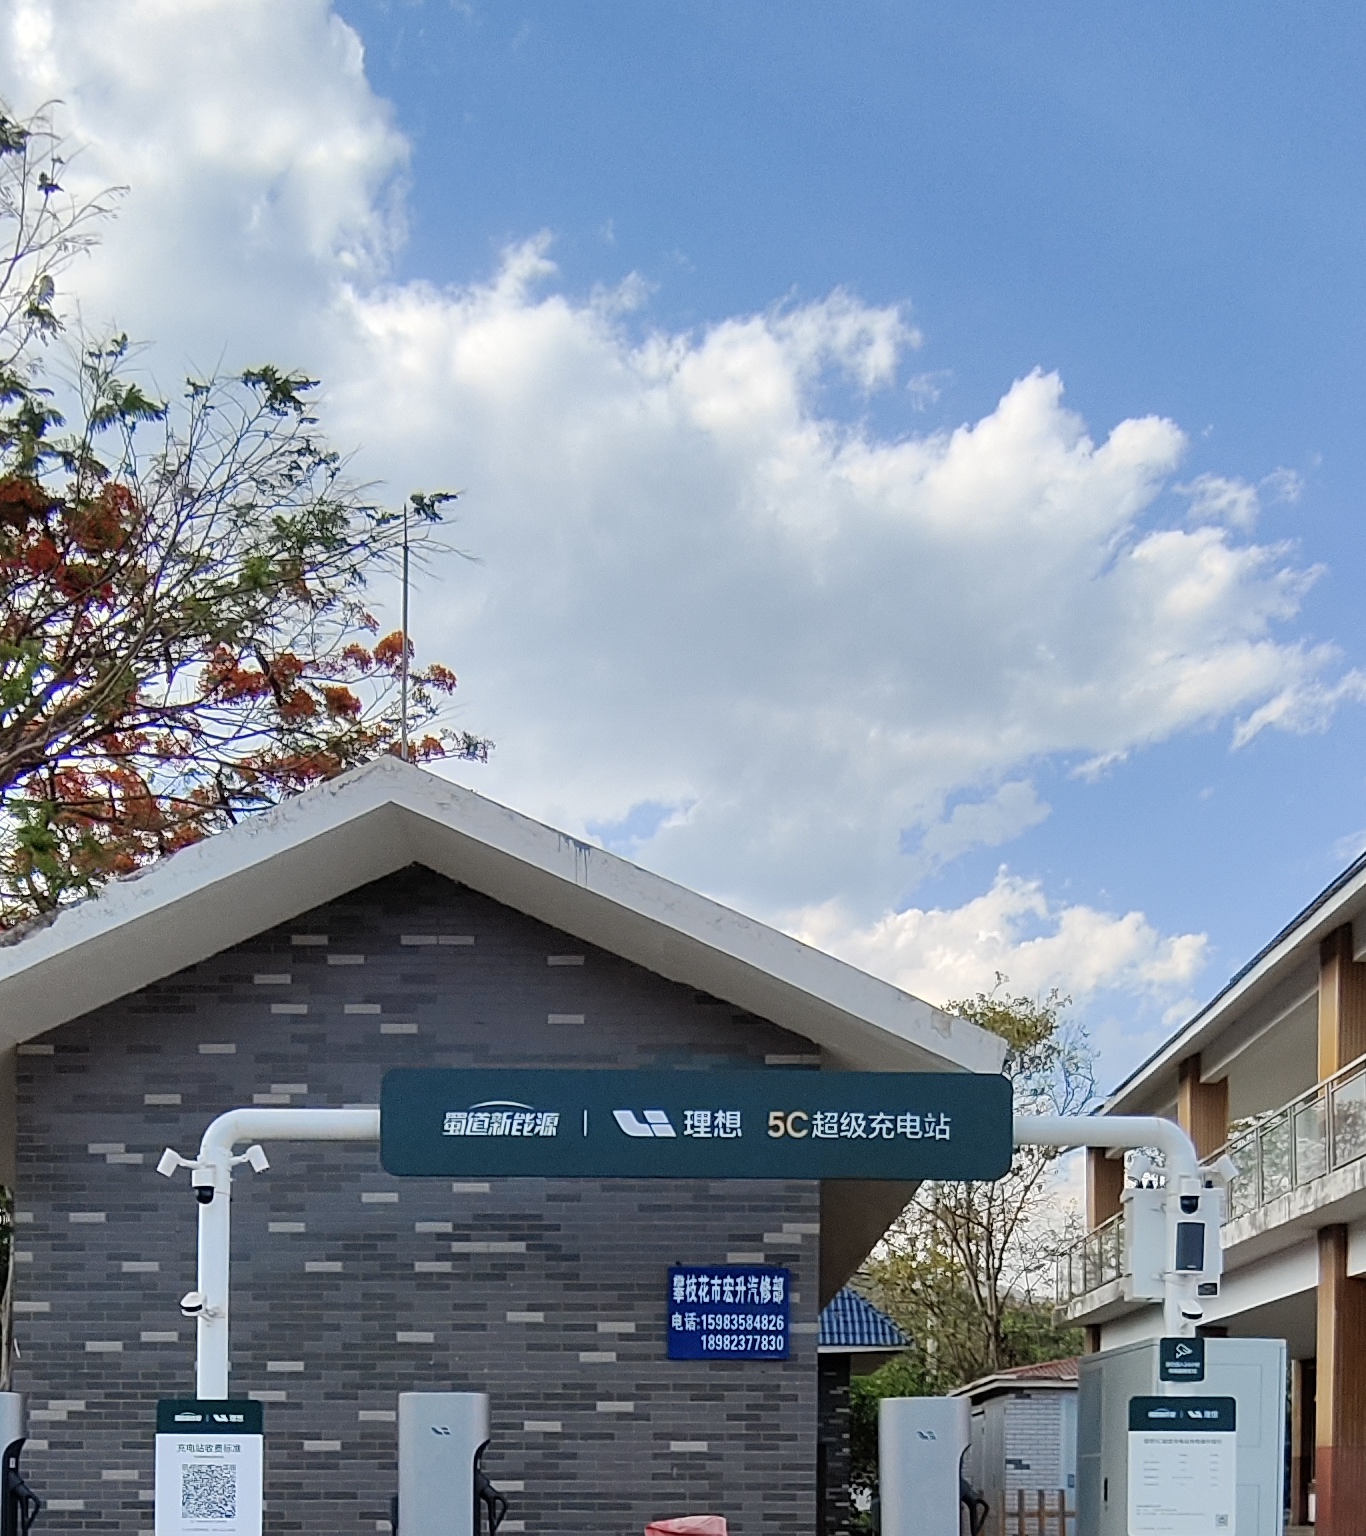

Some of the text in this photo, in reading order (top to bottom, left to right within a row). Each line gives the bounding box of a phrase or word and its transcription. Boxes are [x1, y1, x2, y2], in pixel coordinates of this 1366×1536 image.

[442, 1111, 560, 1137] 蜀道新能源
[683, 1110, 952, 1141] 理想 5C超级充电站
[672, 1274, 785, 1304] 攀枝花市宏升汽修部
[700, 1334, 784, 1351] 18982377830
